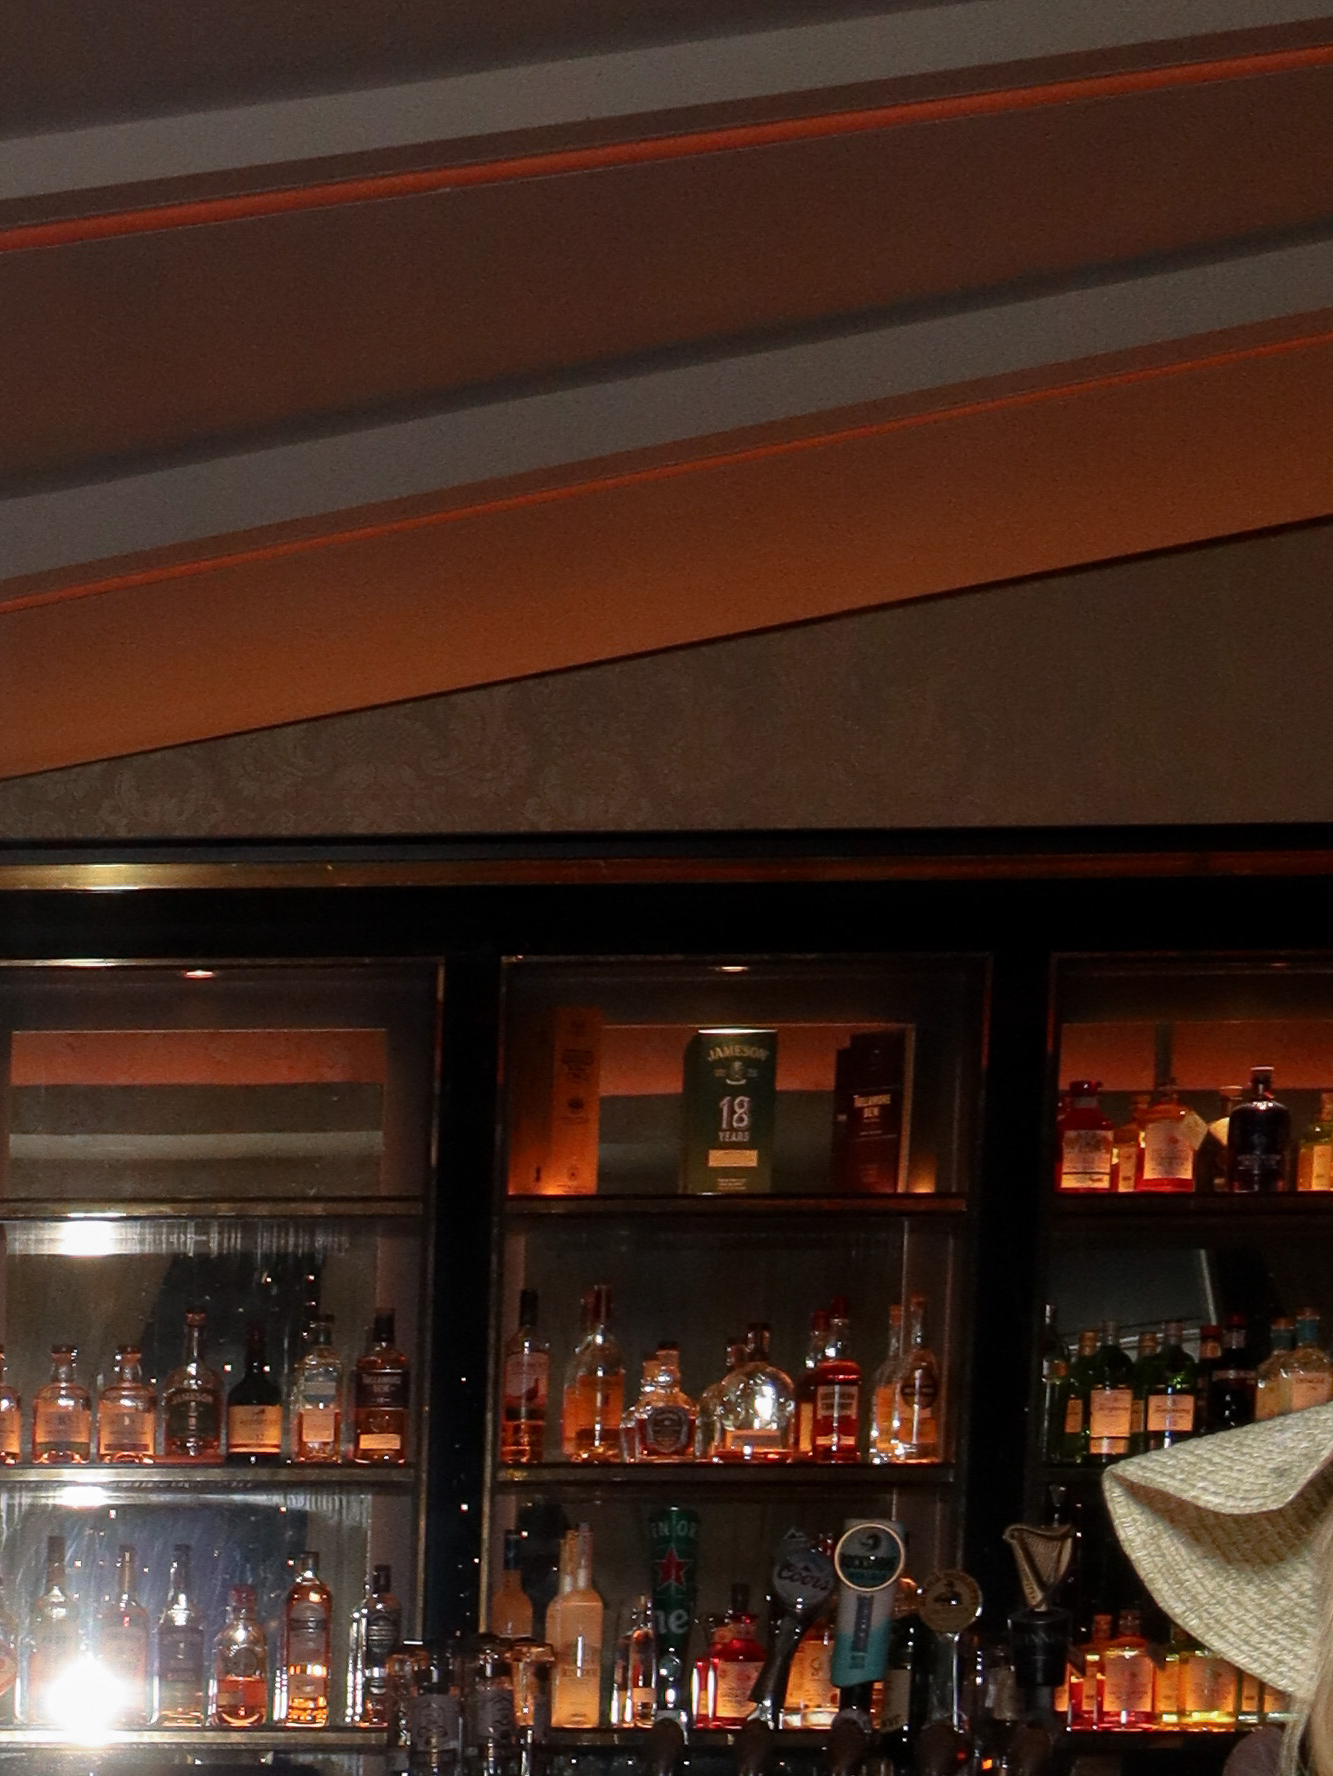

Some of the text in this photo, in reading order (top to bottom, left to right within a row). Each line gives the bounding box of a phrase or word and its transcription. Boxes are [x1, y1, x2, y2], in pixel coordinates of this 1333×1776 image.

[719, 1096, 751, 1130] 18
[719, 1132, 750, 1142] YEARS
[778, 1565, 828, 1591] Coors
